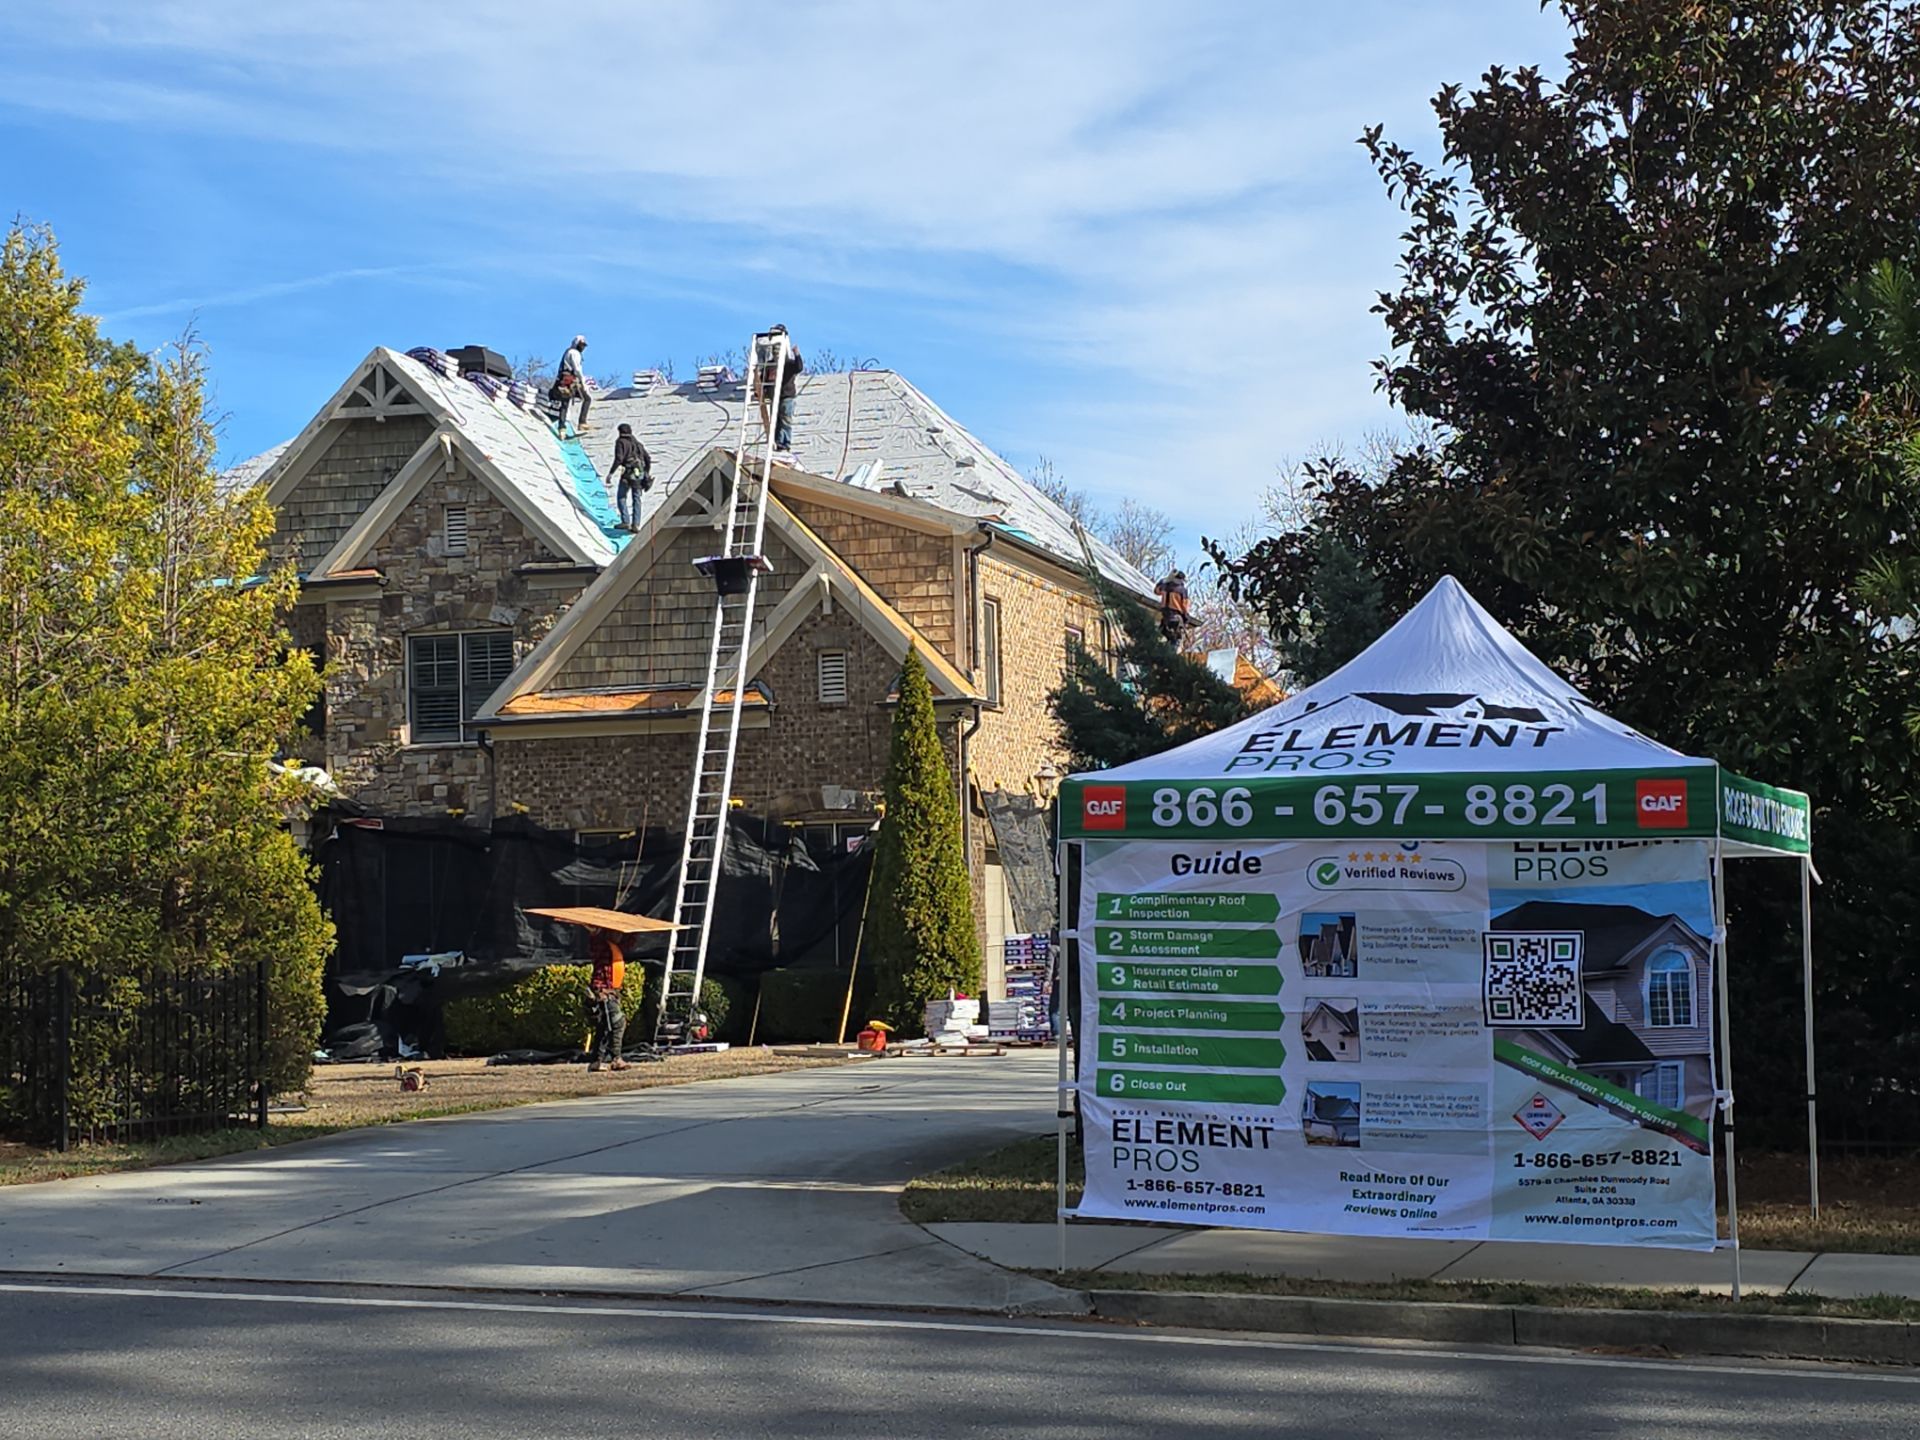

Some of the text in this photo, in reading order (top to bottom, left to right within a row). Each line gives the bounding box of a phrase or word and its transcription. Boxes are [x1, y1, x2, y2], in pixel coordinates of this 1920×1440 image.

[1239, 721, 1564, 753] ELEMENT
[1223, 750, 1396, 772] PROS
[1086, 800, 1122, 816] GAF
[1152, 787, 1253, 827] 866
[1464, 783, 1608, 826] 8821
[1641, 795, 1682, 811] GAF
[1171, 850, 1262, 876] Guide
[1514, 856, 1608, 881] PROS
[1345, 867, 1455, 881] Verified Reviews
[1109, 895, 1246, 914] 1 Complimentary Roof
[1129, 908, 1190, 919] Inspection
[1109, 930, 1213, 950] 2 Storm Damage
[1131, 944, 1200, 955] Assessment
[1111, 966, 1238, 985] 3 Insurance Claim or
[1133, 979, 1219, 991] Retail Estimate
[1111, 1002, 1227, 1022] 4 Project Planning
[1112, 1038, 1199, 1057] 5 Installation
[1110, 1073, 1187, 1092] 6 Close Out
[1521, 1055, 1541, 1070] ROOF
[1541, 1063, 1598, 1094] REPLACEMENT
[1603, 1093, 1636, 1113] REPAIRS
[1113, 1119, 1274, 1149] ELEMENT
[1113, 1146, 1200, 1172] PROS
[1514, 1149, 1682, 1168] 1-866-657-8821
[1126, 1178, 1266, 1198] 1-866-657-8821
[1340, 1171, 1449, 1187] Read More Of Our
[1554, 1176, 1598, 1185] Chamblee
[1601, 1175, 1648, 1185] Dunwoody
[1650, 1176, 1670, 1185] Road
[1352, 1189, 1436, 1204] Extraordinary
[1555, 1196, 1590, 1205] Atlanta,
[1592, 1197, 1604, 1205] GA
[1124, 1199, 1266, 1214] www.elementpros.com
[1344, 1204, 1437, 1218] Reviews Online
[1525, 1214, 1678, 1228] www.elementpros.com
